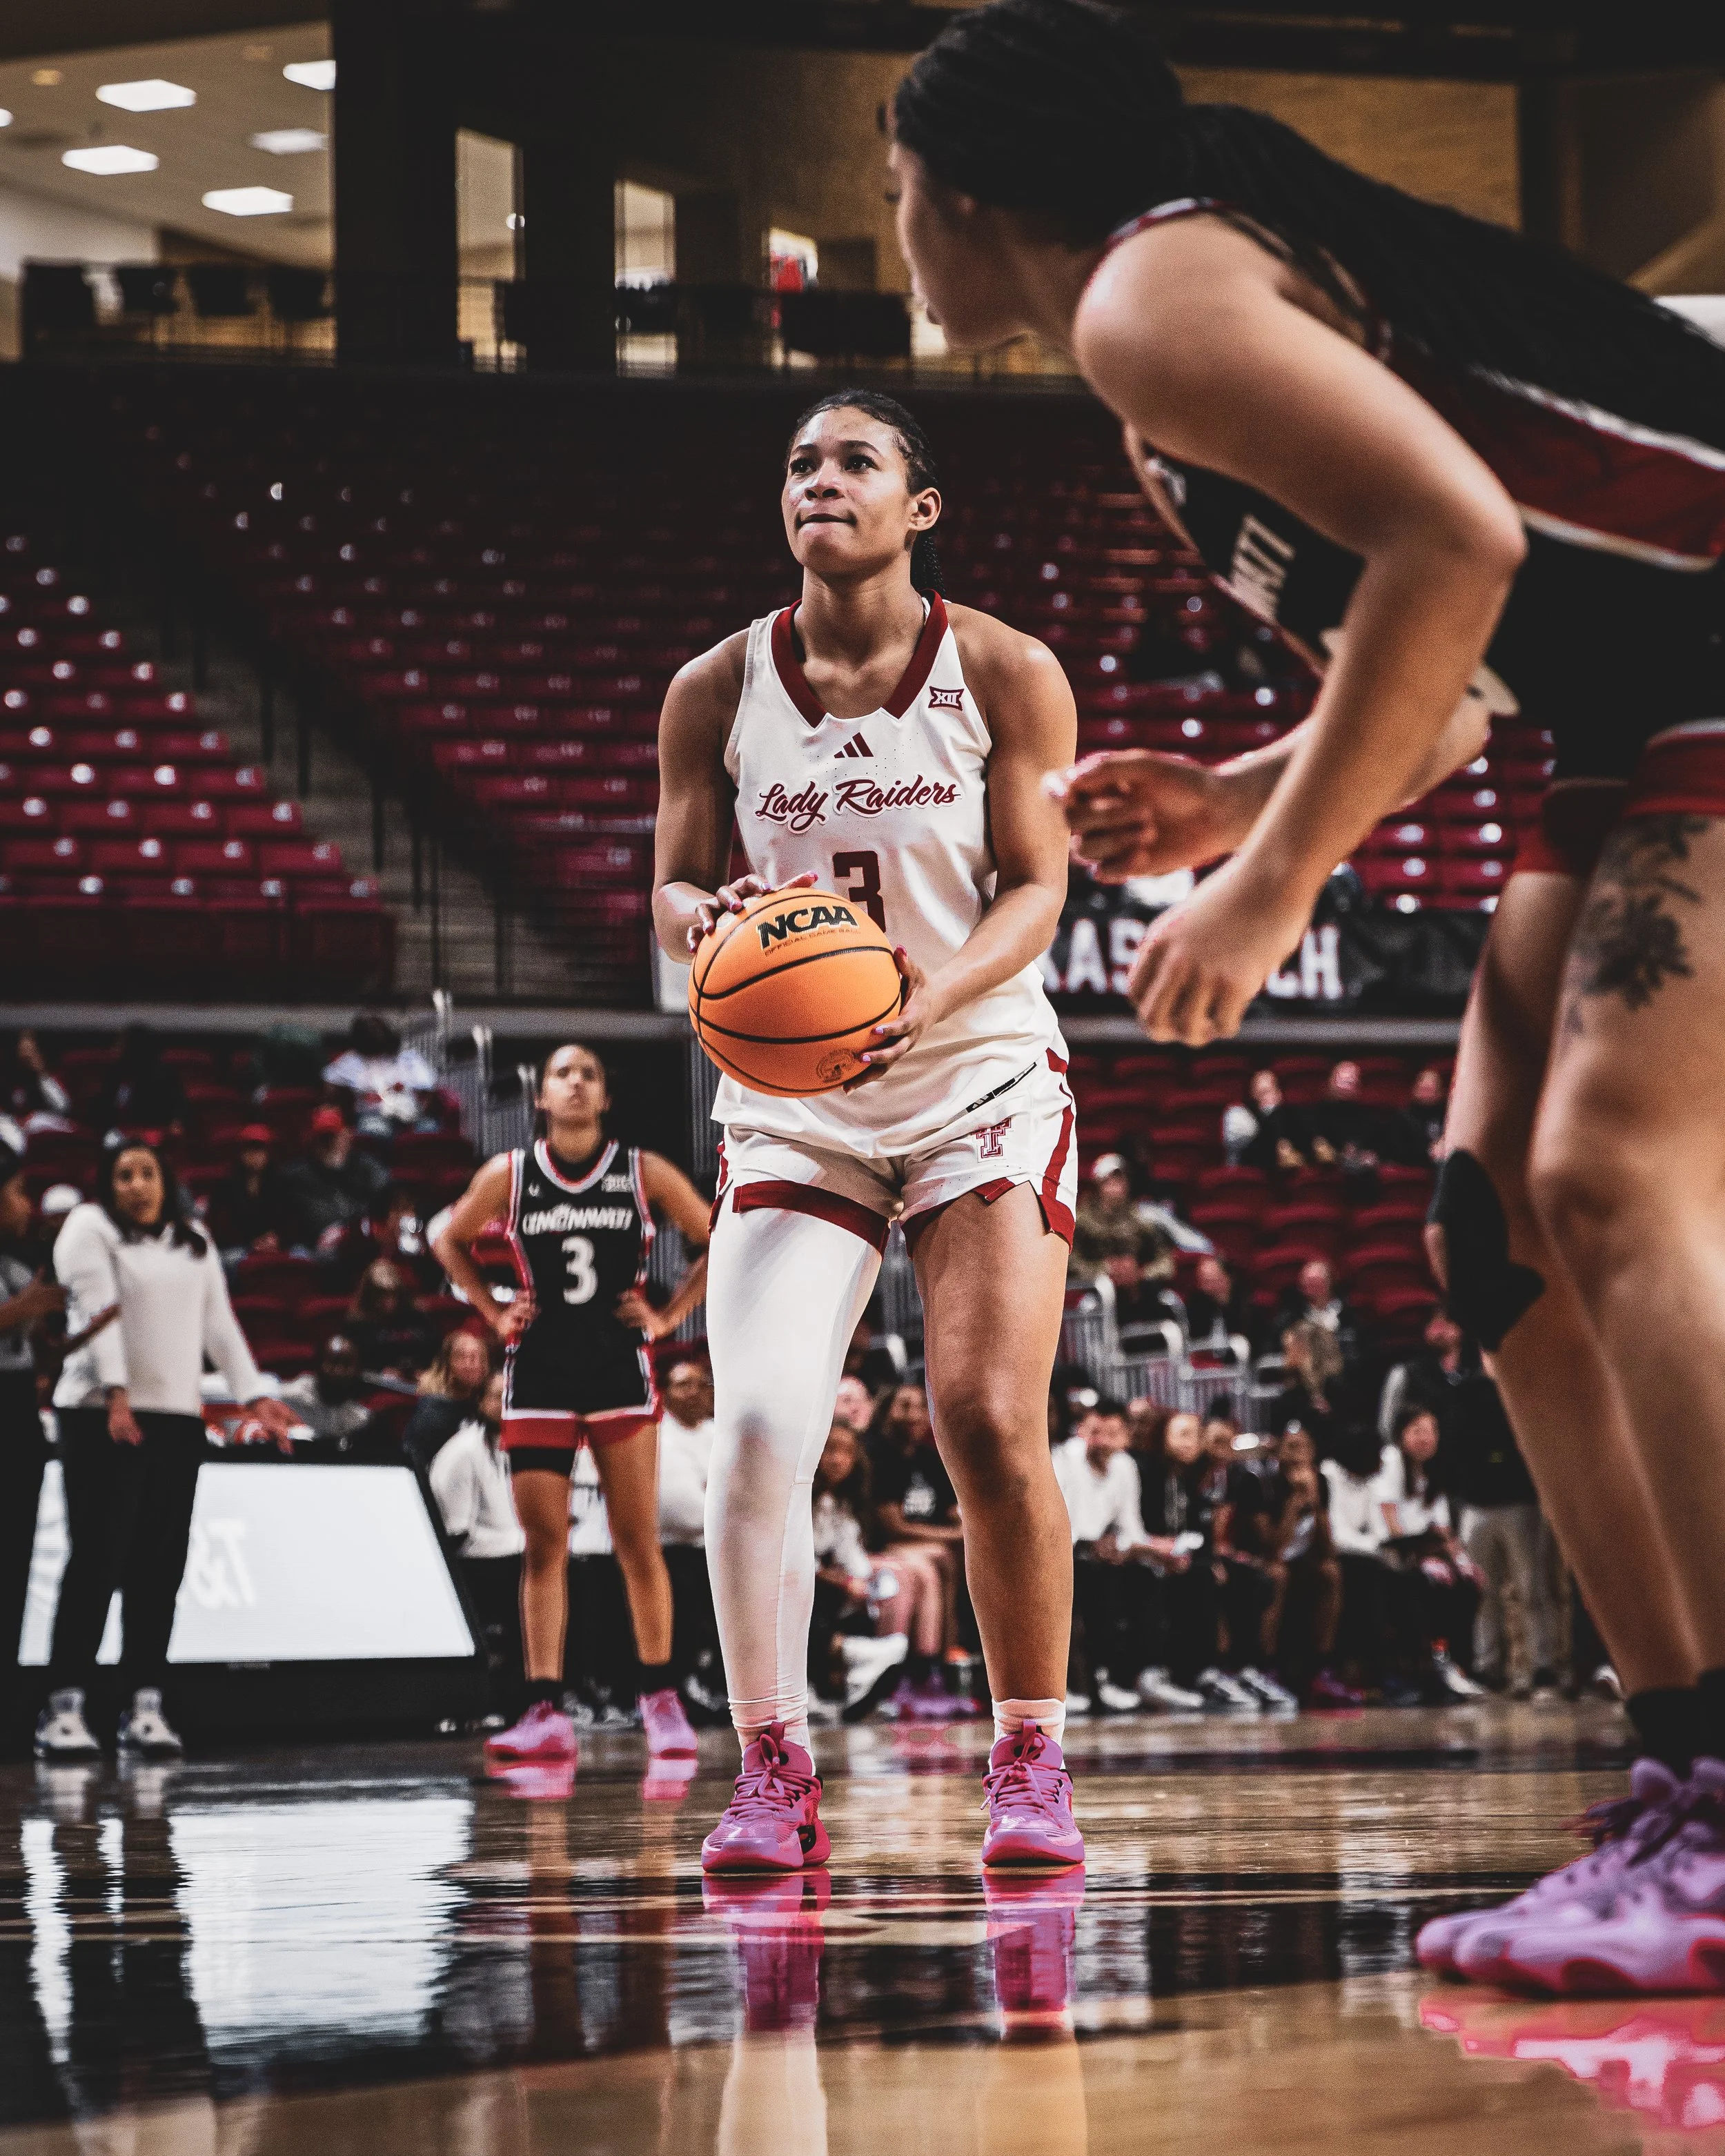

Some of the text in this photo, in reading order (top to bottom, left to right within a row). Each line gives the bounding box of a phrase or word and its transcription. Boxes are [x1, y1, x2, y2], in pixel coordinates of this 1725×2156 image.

[756, 774, 962, 832] Lady Raiders
[832, 850, 887, 933] 3
[757, 905, 859, 949] NCAA
[764, 936, 807, 956] OFFICIAL
[562, 1236, 598, 1305] 3
